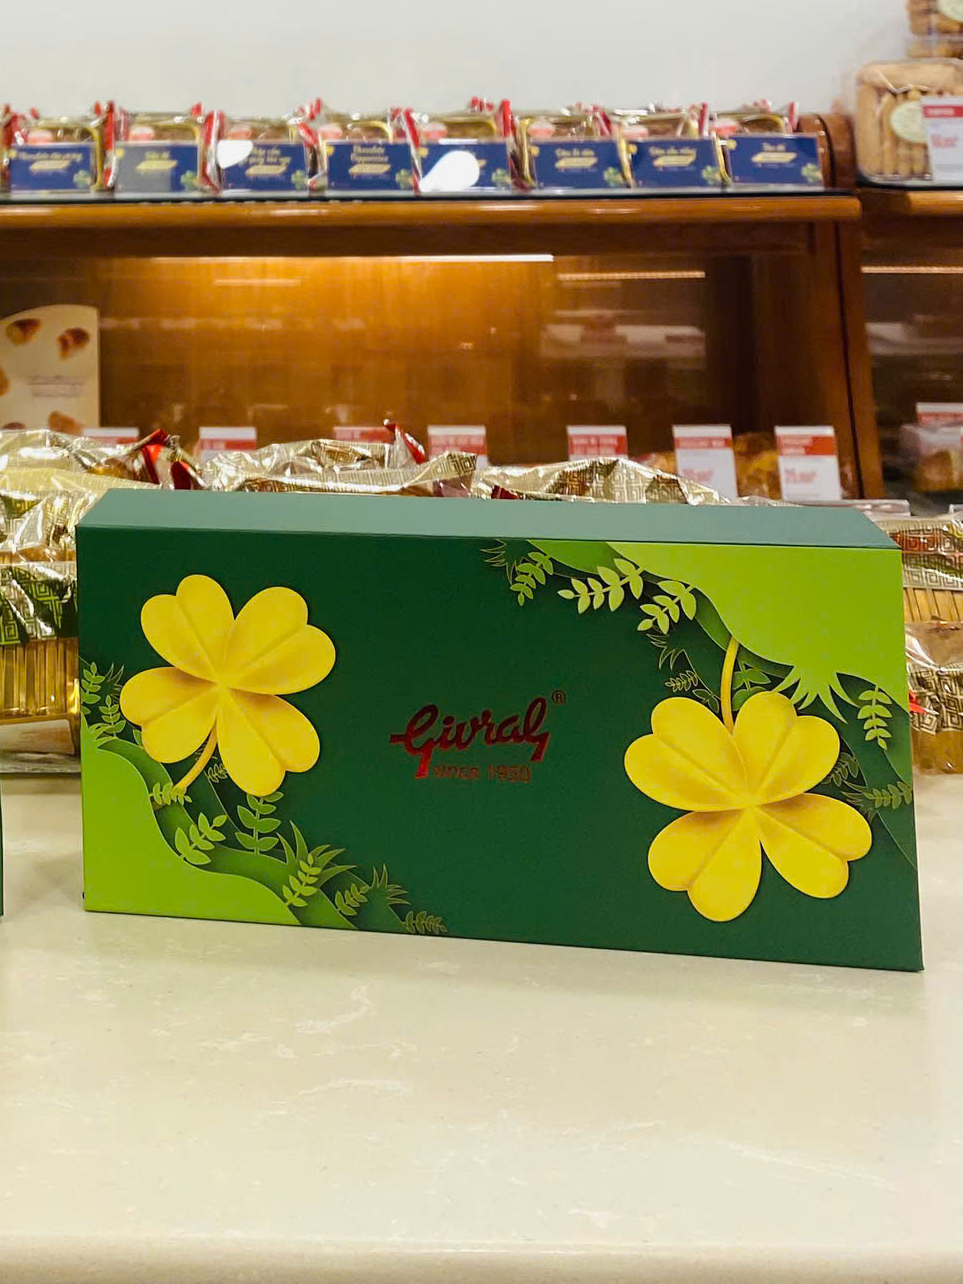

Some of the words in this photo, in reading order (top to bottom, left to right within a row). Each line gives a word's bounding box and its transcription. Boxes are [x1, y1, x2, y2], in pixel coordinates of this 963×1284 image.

[389, 696, 550, 780] Givral
[434, 764, 480, 781] since
[488, 764, 532, 783] 1950
